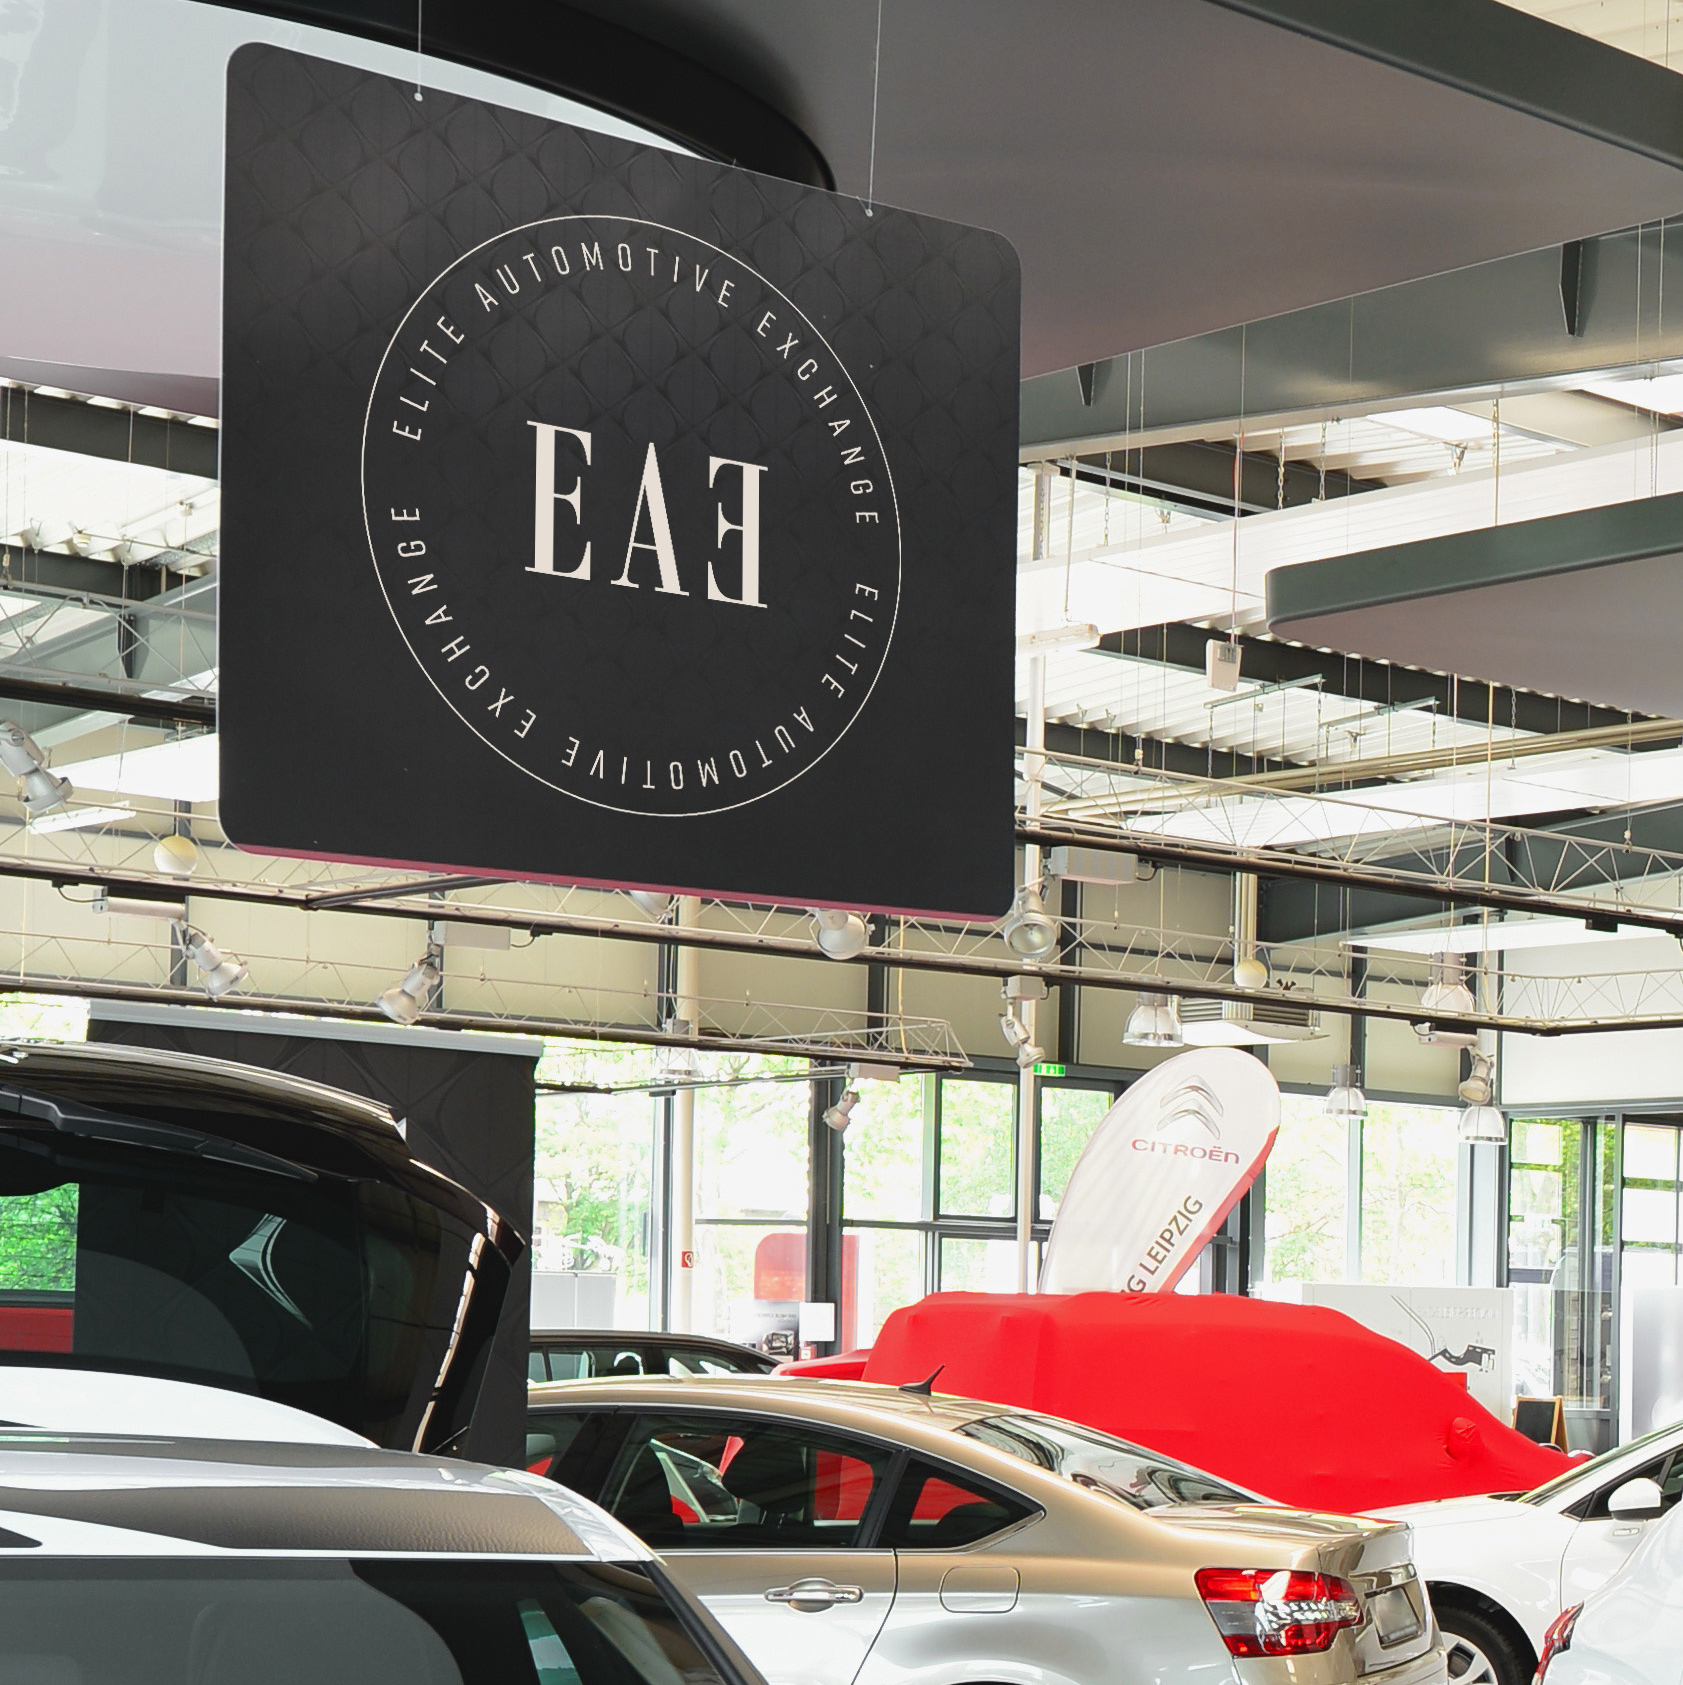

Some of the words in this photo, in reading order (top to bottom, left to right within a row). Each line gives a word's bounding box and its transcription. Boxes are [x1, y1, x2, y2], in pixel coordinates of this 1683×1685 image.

[392, 316, 465, 441] ELITE
[473, 240, 735, 313] AUTOMOTIVE
[757, 312, 880, 527] EXCHANGE
[391, 506, 538, 740] EXCHANGE
[822, 583, 880, 701] ELITE
[561, 706, 815, 791] AUTOMOTIVE
[1138, 1195, 1203, 1276] LEIPZIG
